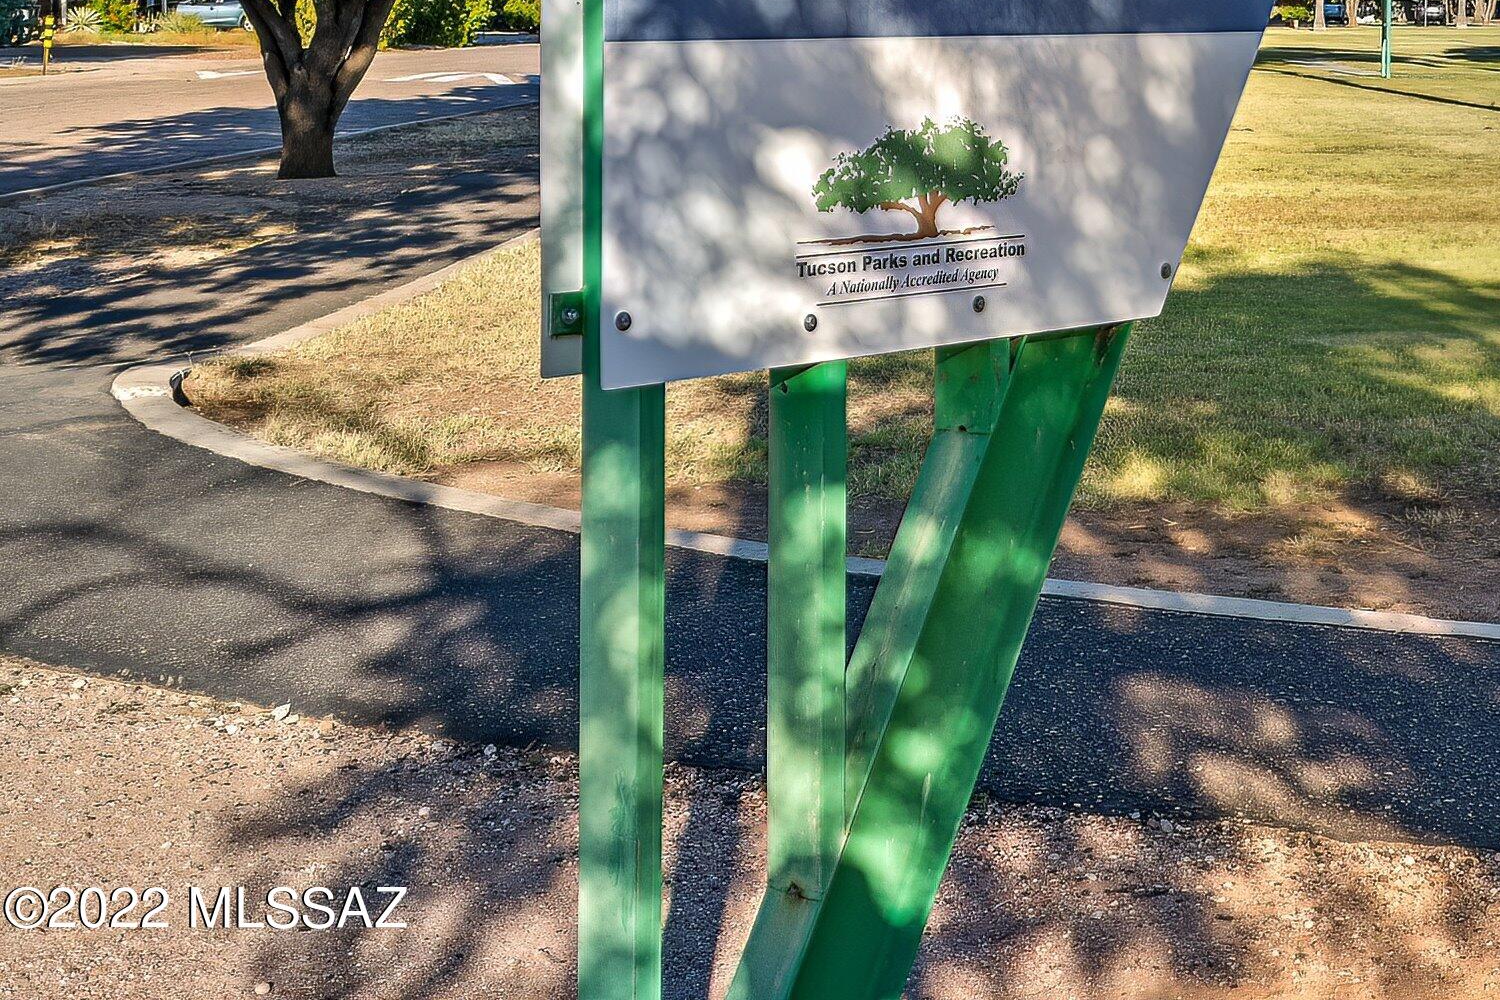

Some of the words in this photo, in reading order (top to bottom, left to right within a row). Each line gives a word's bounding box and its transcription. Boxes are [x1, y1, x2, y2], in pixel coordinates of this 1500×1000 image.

[796, 260, 857, 278] Tucson
[862, 252, 908, 272] Parks
[912, 249, 940, 267] and
[945, 242, 1026, 264] Recreation
[826, 280, 837, 296] A
[839, 274, 900, 295] Nationally
[900, 267, 960, 289] Accredited
[960, 266, 999, 285] Agency
